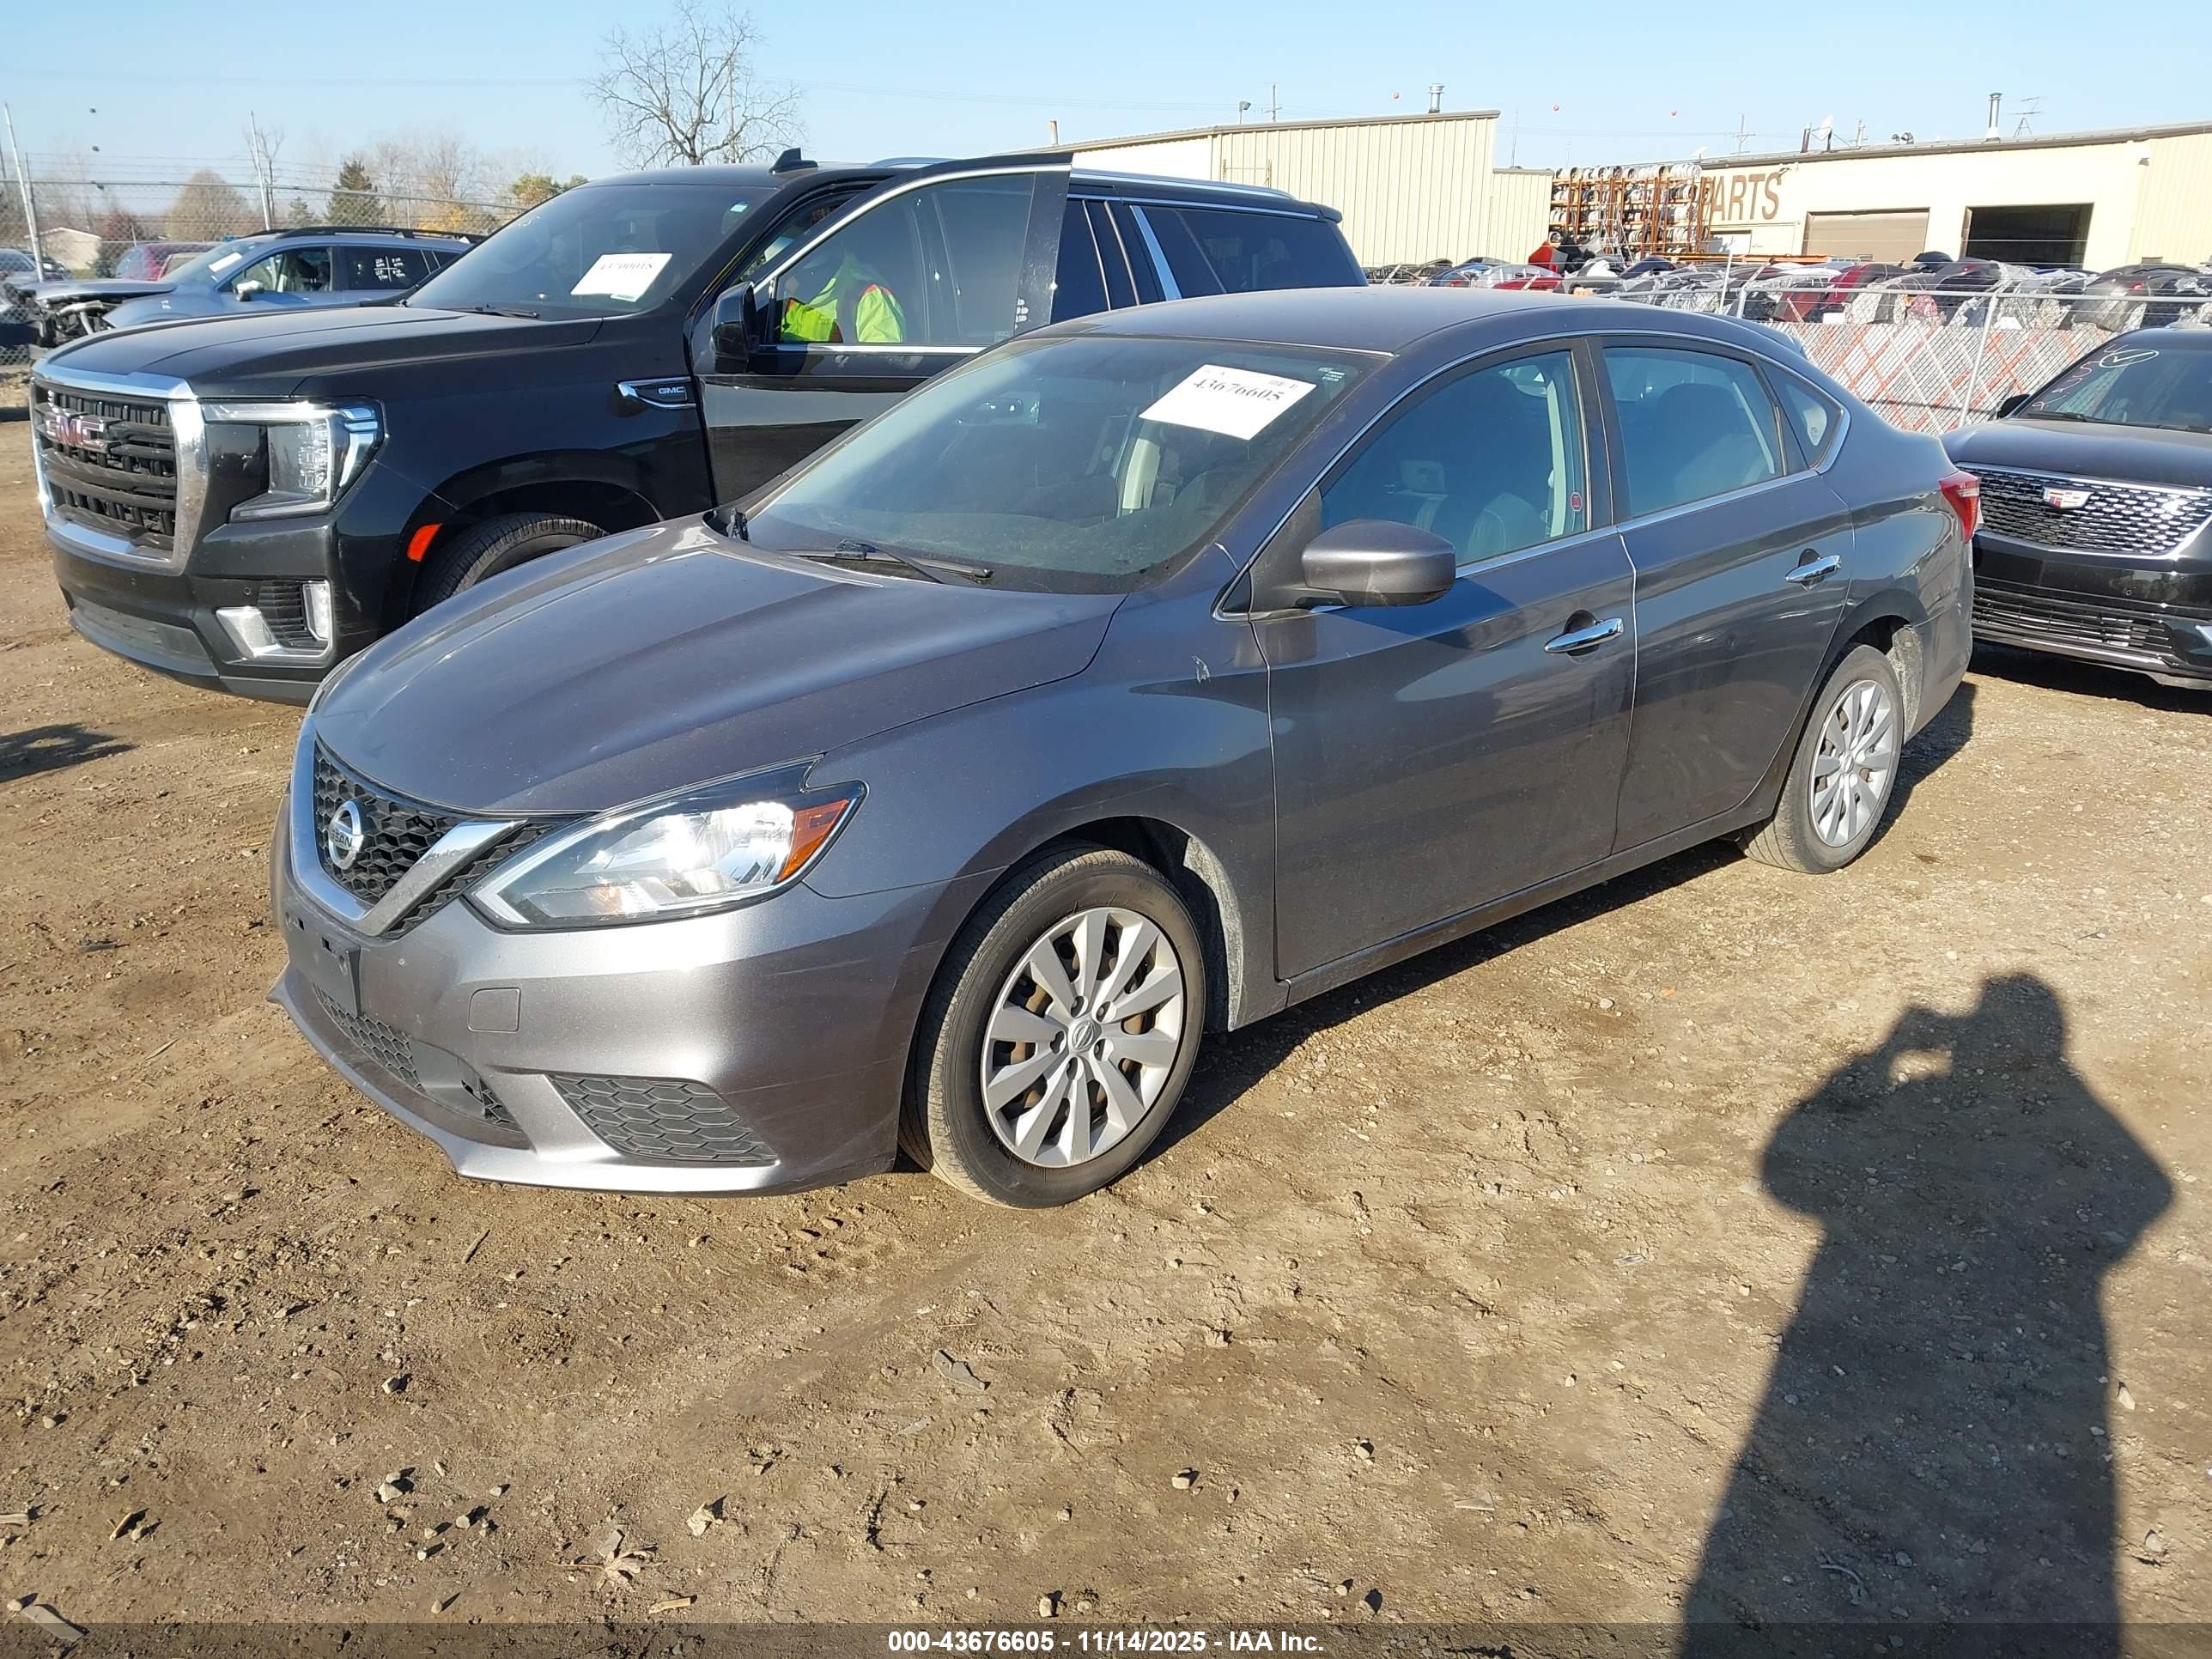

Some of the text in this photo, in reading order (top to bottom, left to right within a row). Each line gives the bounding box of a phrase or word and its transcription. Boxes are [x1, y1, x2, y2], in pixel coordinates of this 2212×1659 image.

[658, 386, 685, 395] GMC
[1193, 378, 1285, 402] 43676605
[45, 413, 105, 450] GMC
